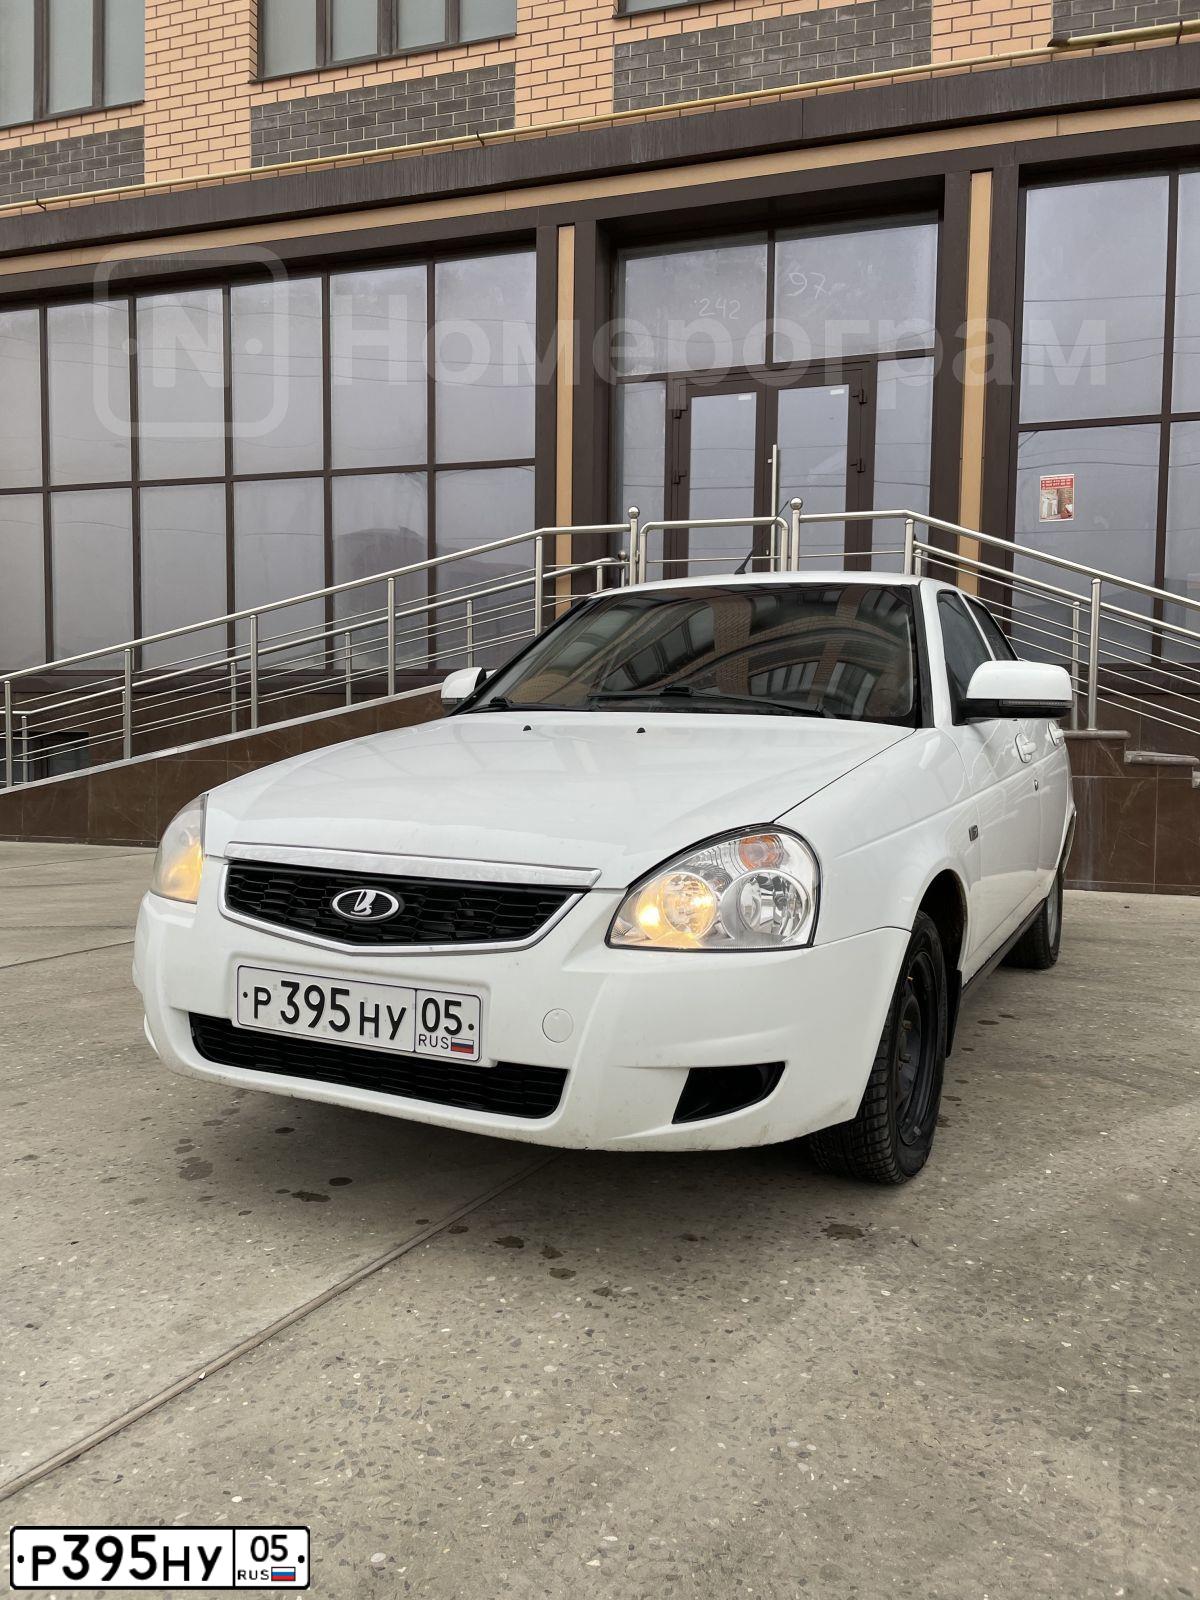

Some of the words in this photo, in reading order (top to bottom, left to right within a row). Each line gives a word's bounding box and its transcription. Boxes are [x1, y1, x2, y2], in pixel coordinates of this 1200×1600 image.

[699, 297, 741, 320] 242
[421, 997, 463, 1035] 05
[418, 1034, 449, 1050] RUS
